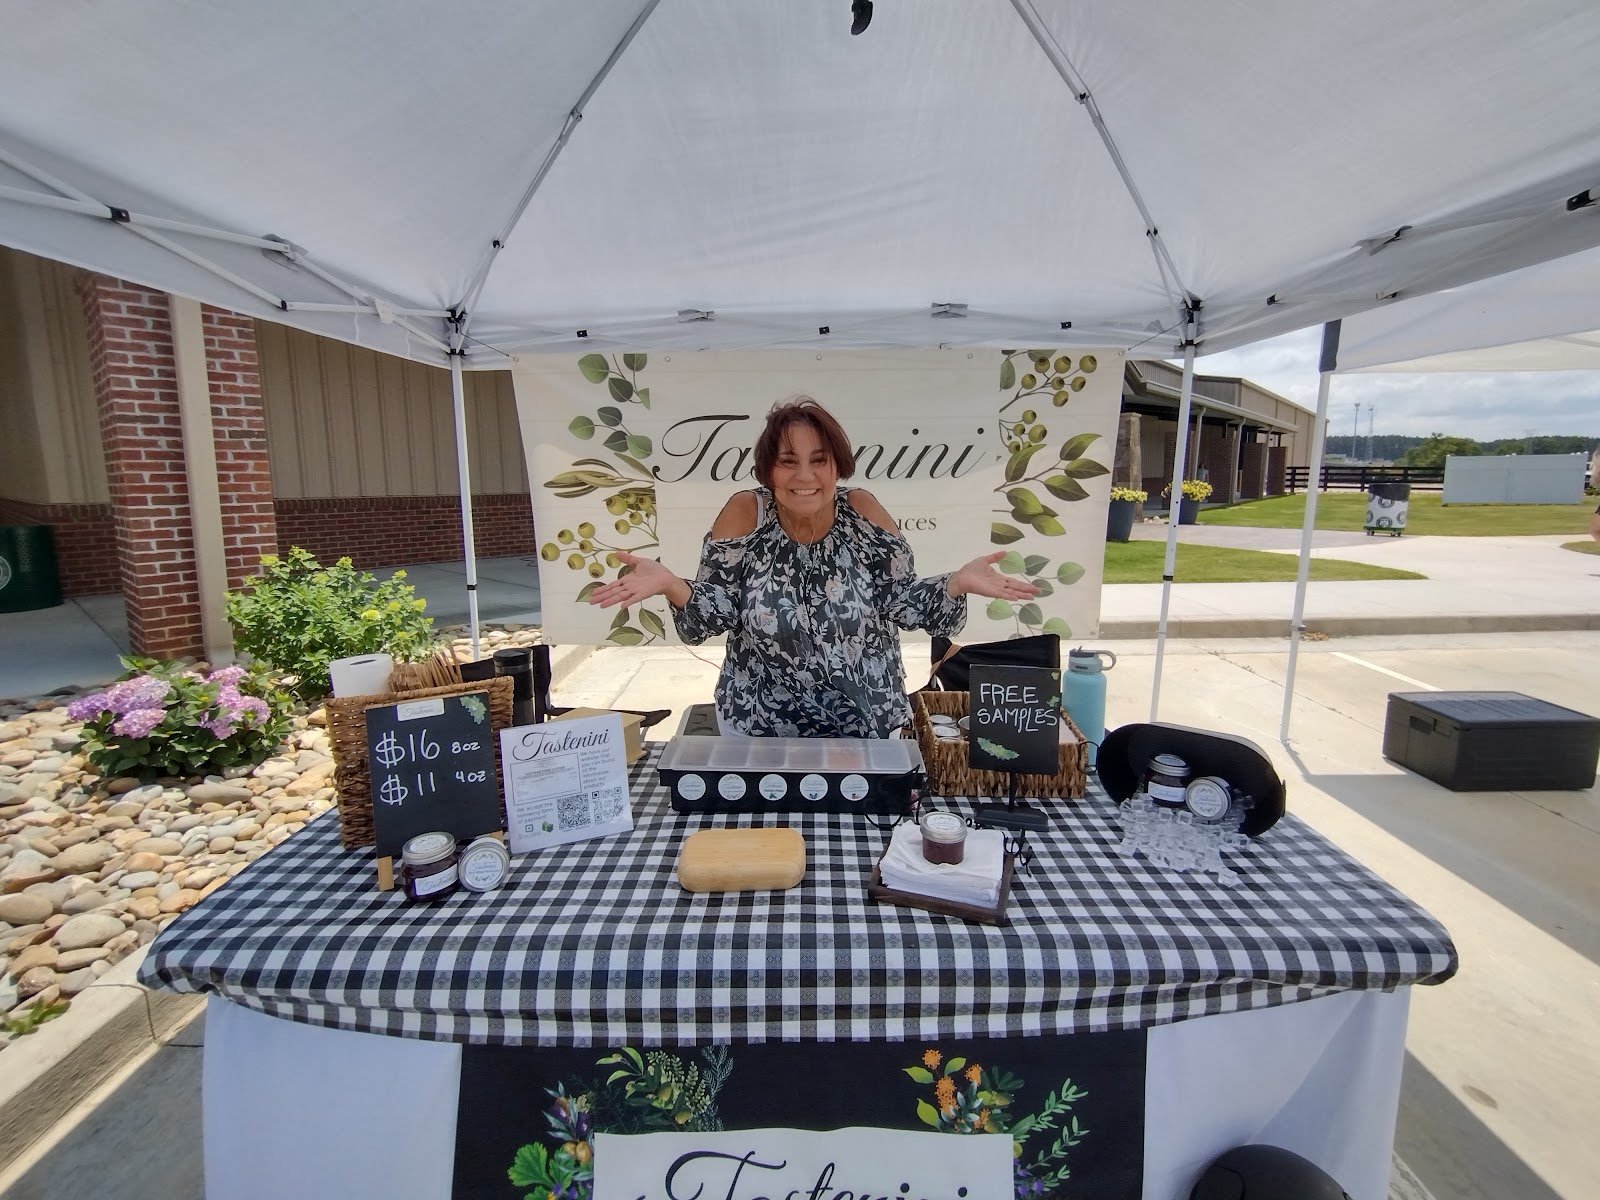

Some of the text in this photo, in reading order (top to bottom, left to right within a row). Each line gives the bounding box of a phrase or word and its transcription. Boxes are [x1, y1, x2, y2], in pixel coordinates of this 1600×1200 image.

[651, 414, 986, 483] Tanini
[980, 683, 1039, 706] FREE
[977, 707, 1058, 733] SAMPLES
[375, 729, 440, 769] $16
[512, 729, 610, 761] Tastenini
